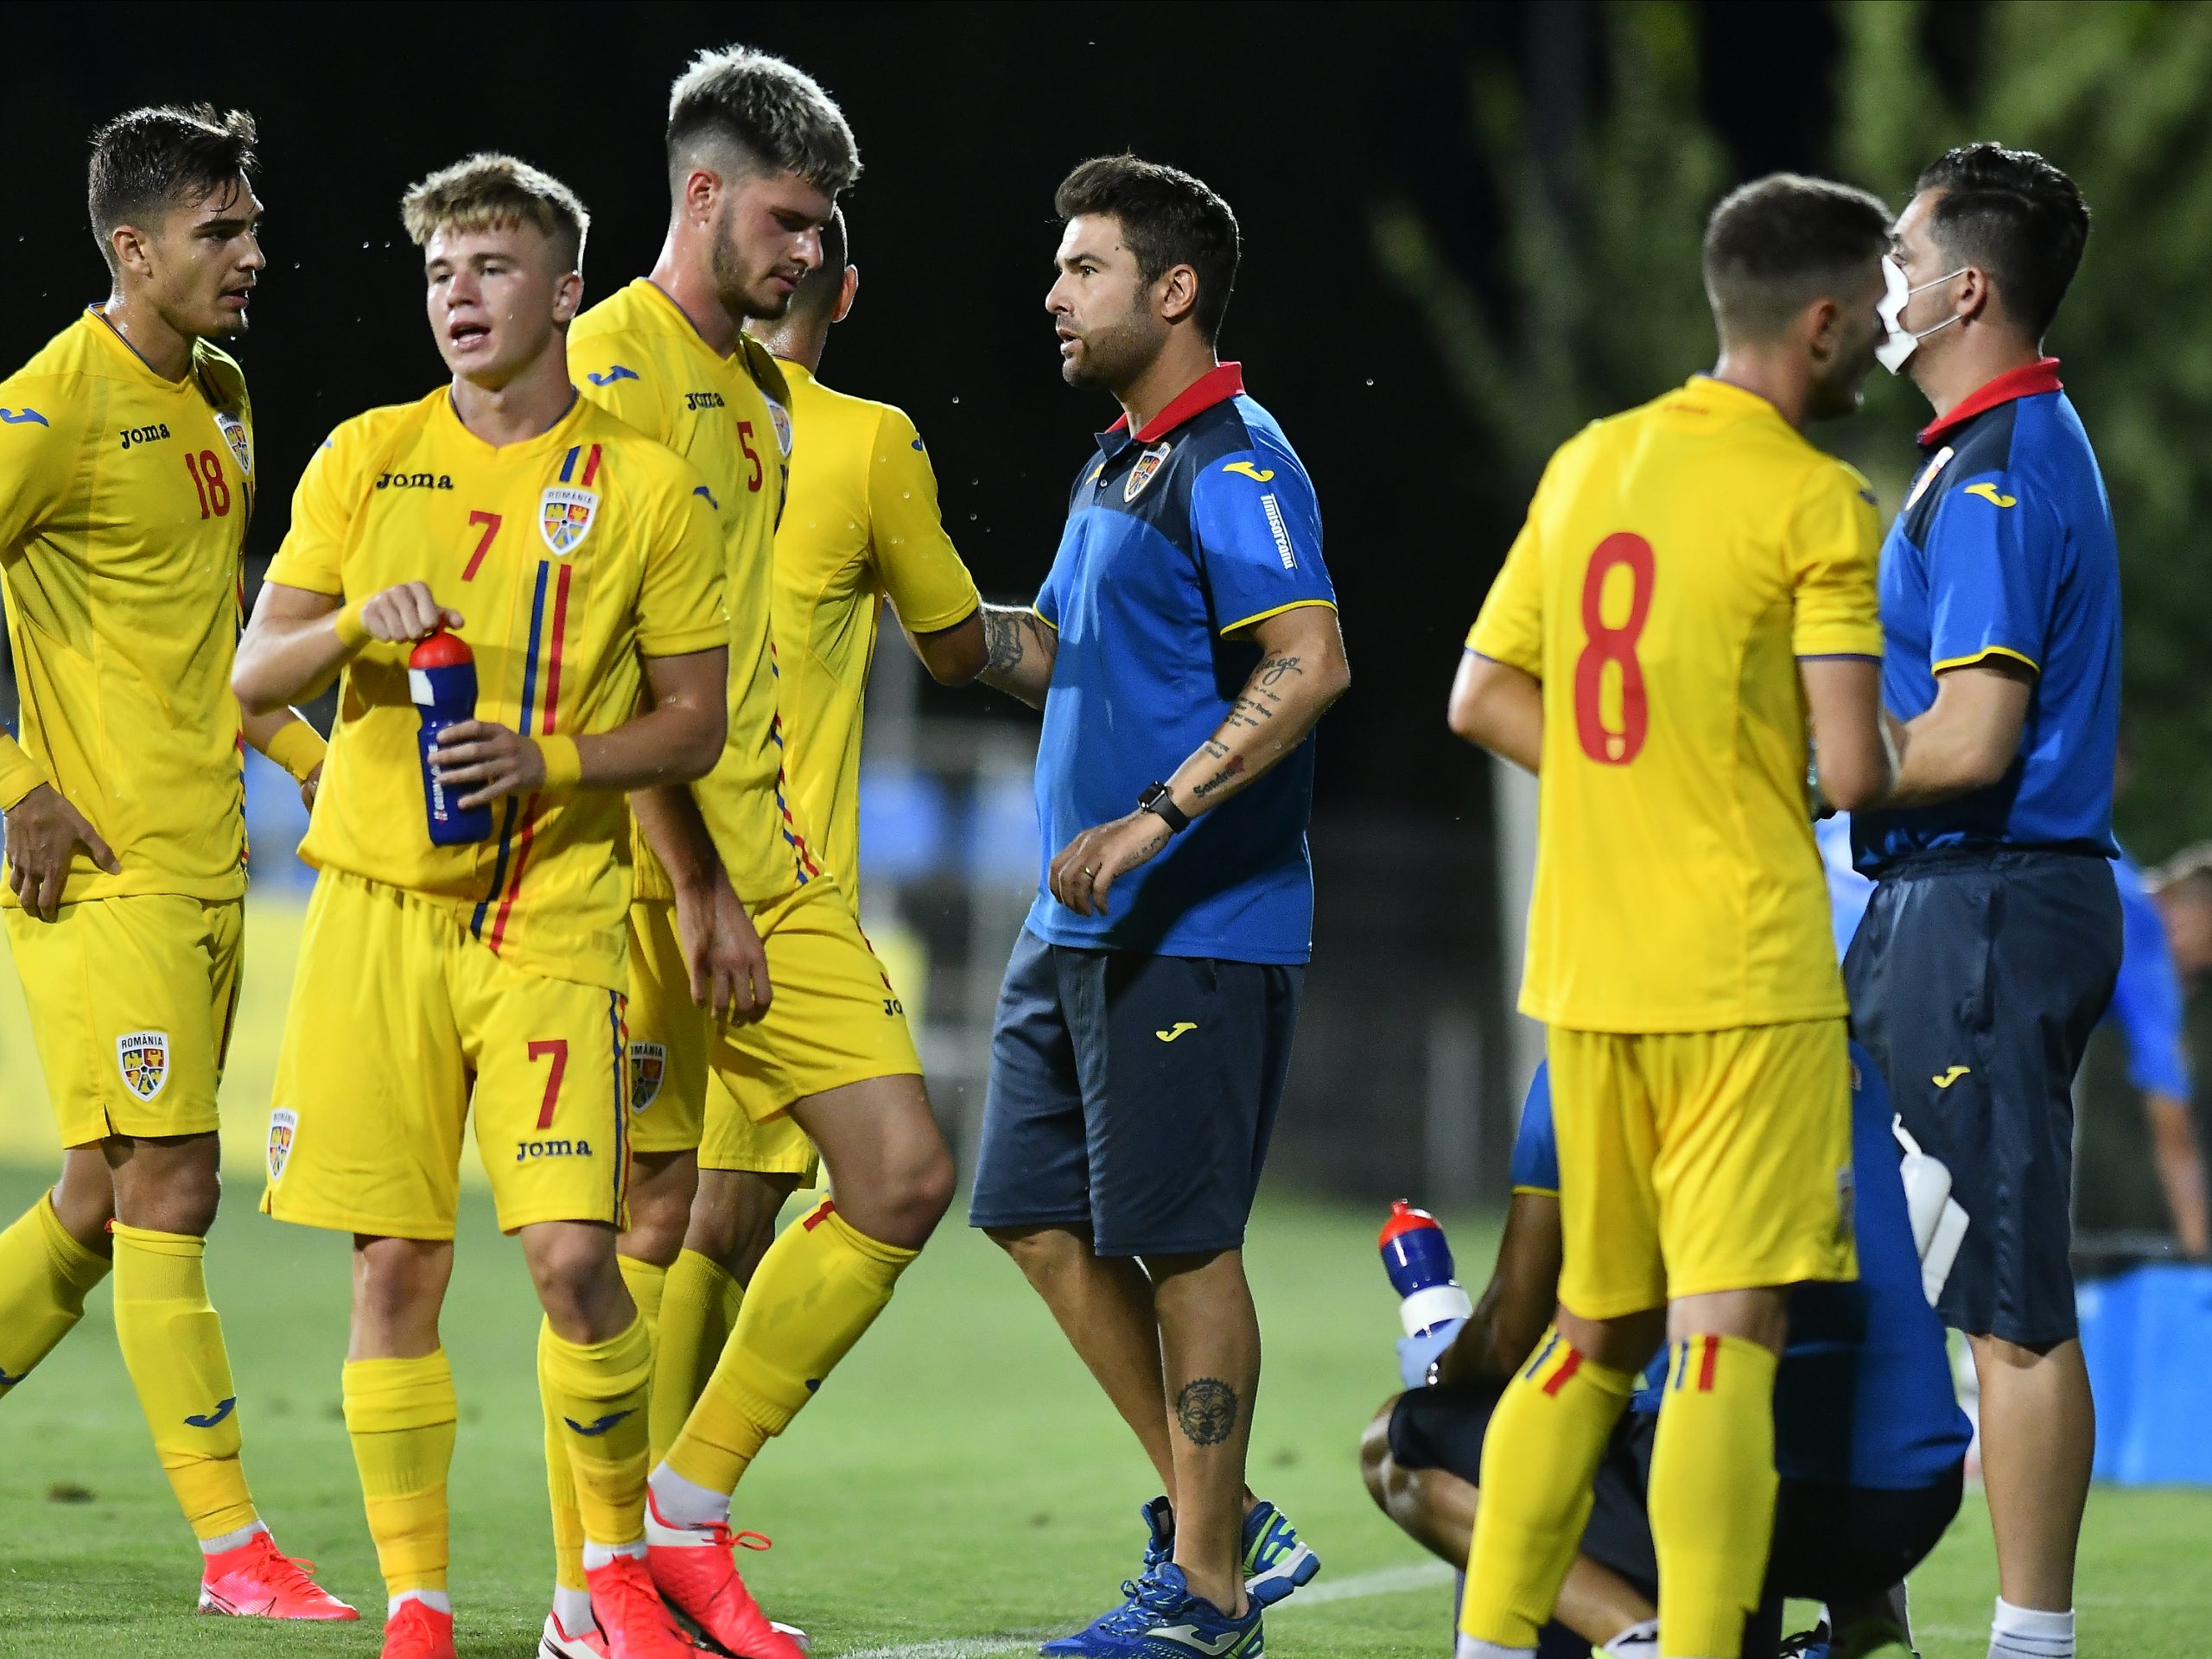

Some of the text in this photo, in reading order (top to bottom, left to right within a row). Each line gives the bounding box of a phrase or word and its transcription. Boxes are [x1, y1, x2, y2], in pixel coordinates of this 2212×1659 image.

[184, 449, 231, 519] 18
[737, 421, 763, 493] 5
[461, 510, 502, 582] 7
[1573, 531, 1656, 767] 8
[121, 1034, 164, 1049] ROMÂNIA
[528, 1039, 568, 1129] 7
